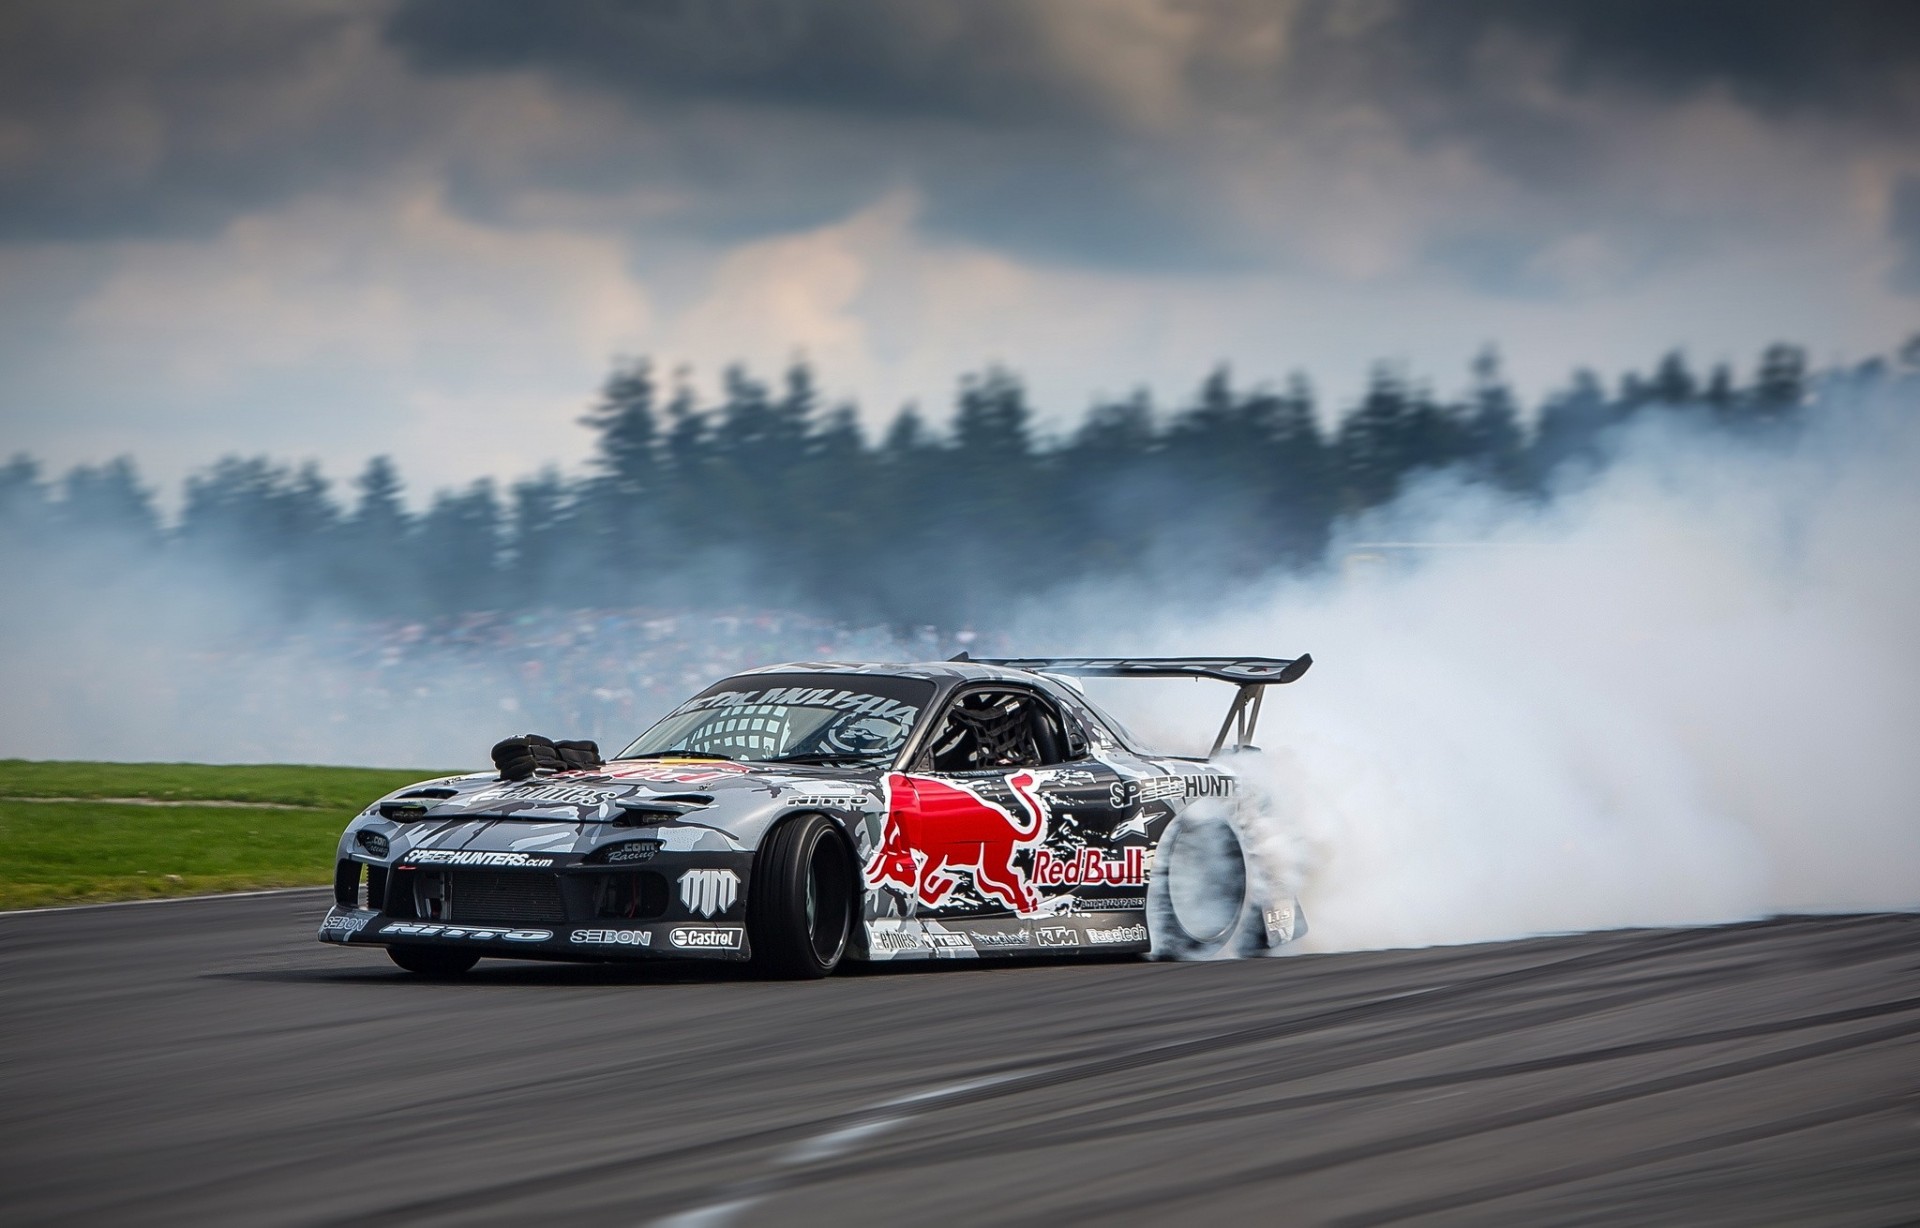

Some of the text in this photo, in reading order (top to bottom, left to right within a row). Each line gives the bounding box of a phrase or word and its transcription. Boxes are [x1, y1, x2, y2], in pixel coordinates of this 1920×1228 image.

[756, 687, 919, 726] MULISHA
[786, 794, 869, 807] NITTO
[607, 849, 656, 863] Racing
[324, 916, 370, 931] SEIBON
[379, 922, 554, 942] NITTO
[570, 929, 652, 946] SEIBON
[687, 930, 734, 946] Castrol
[1035, 926, 1079, 946] KTM
[1086, 923, 1147, 944] Racetech
[934, 934, 971, 947] TEIN
